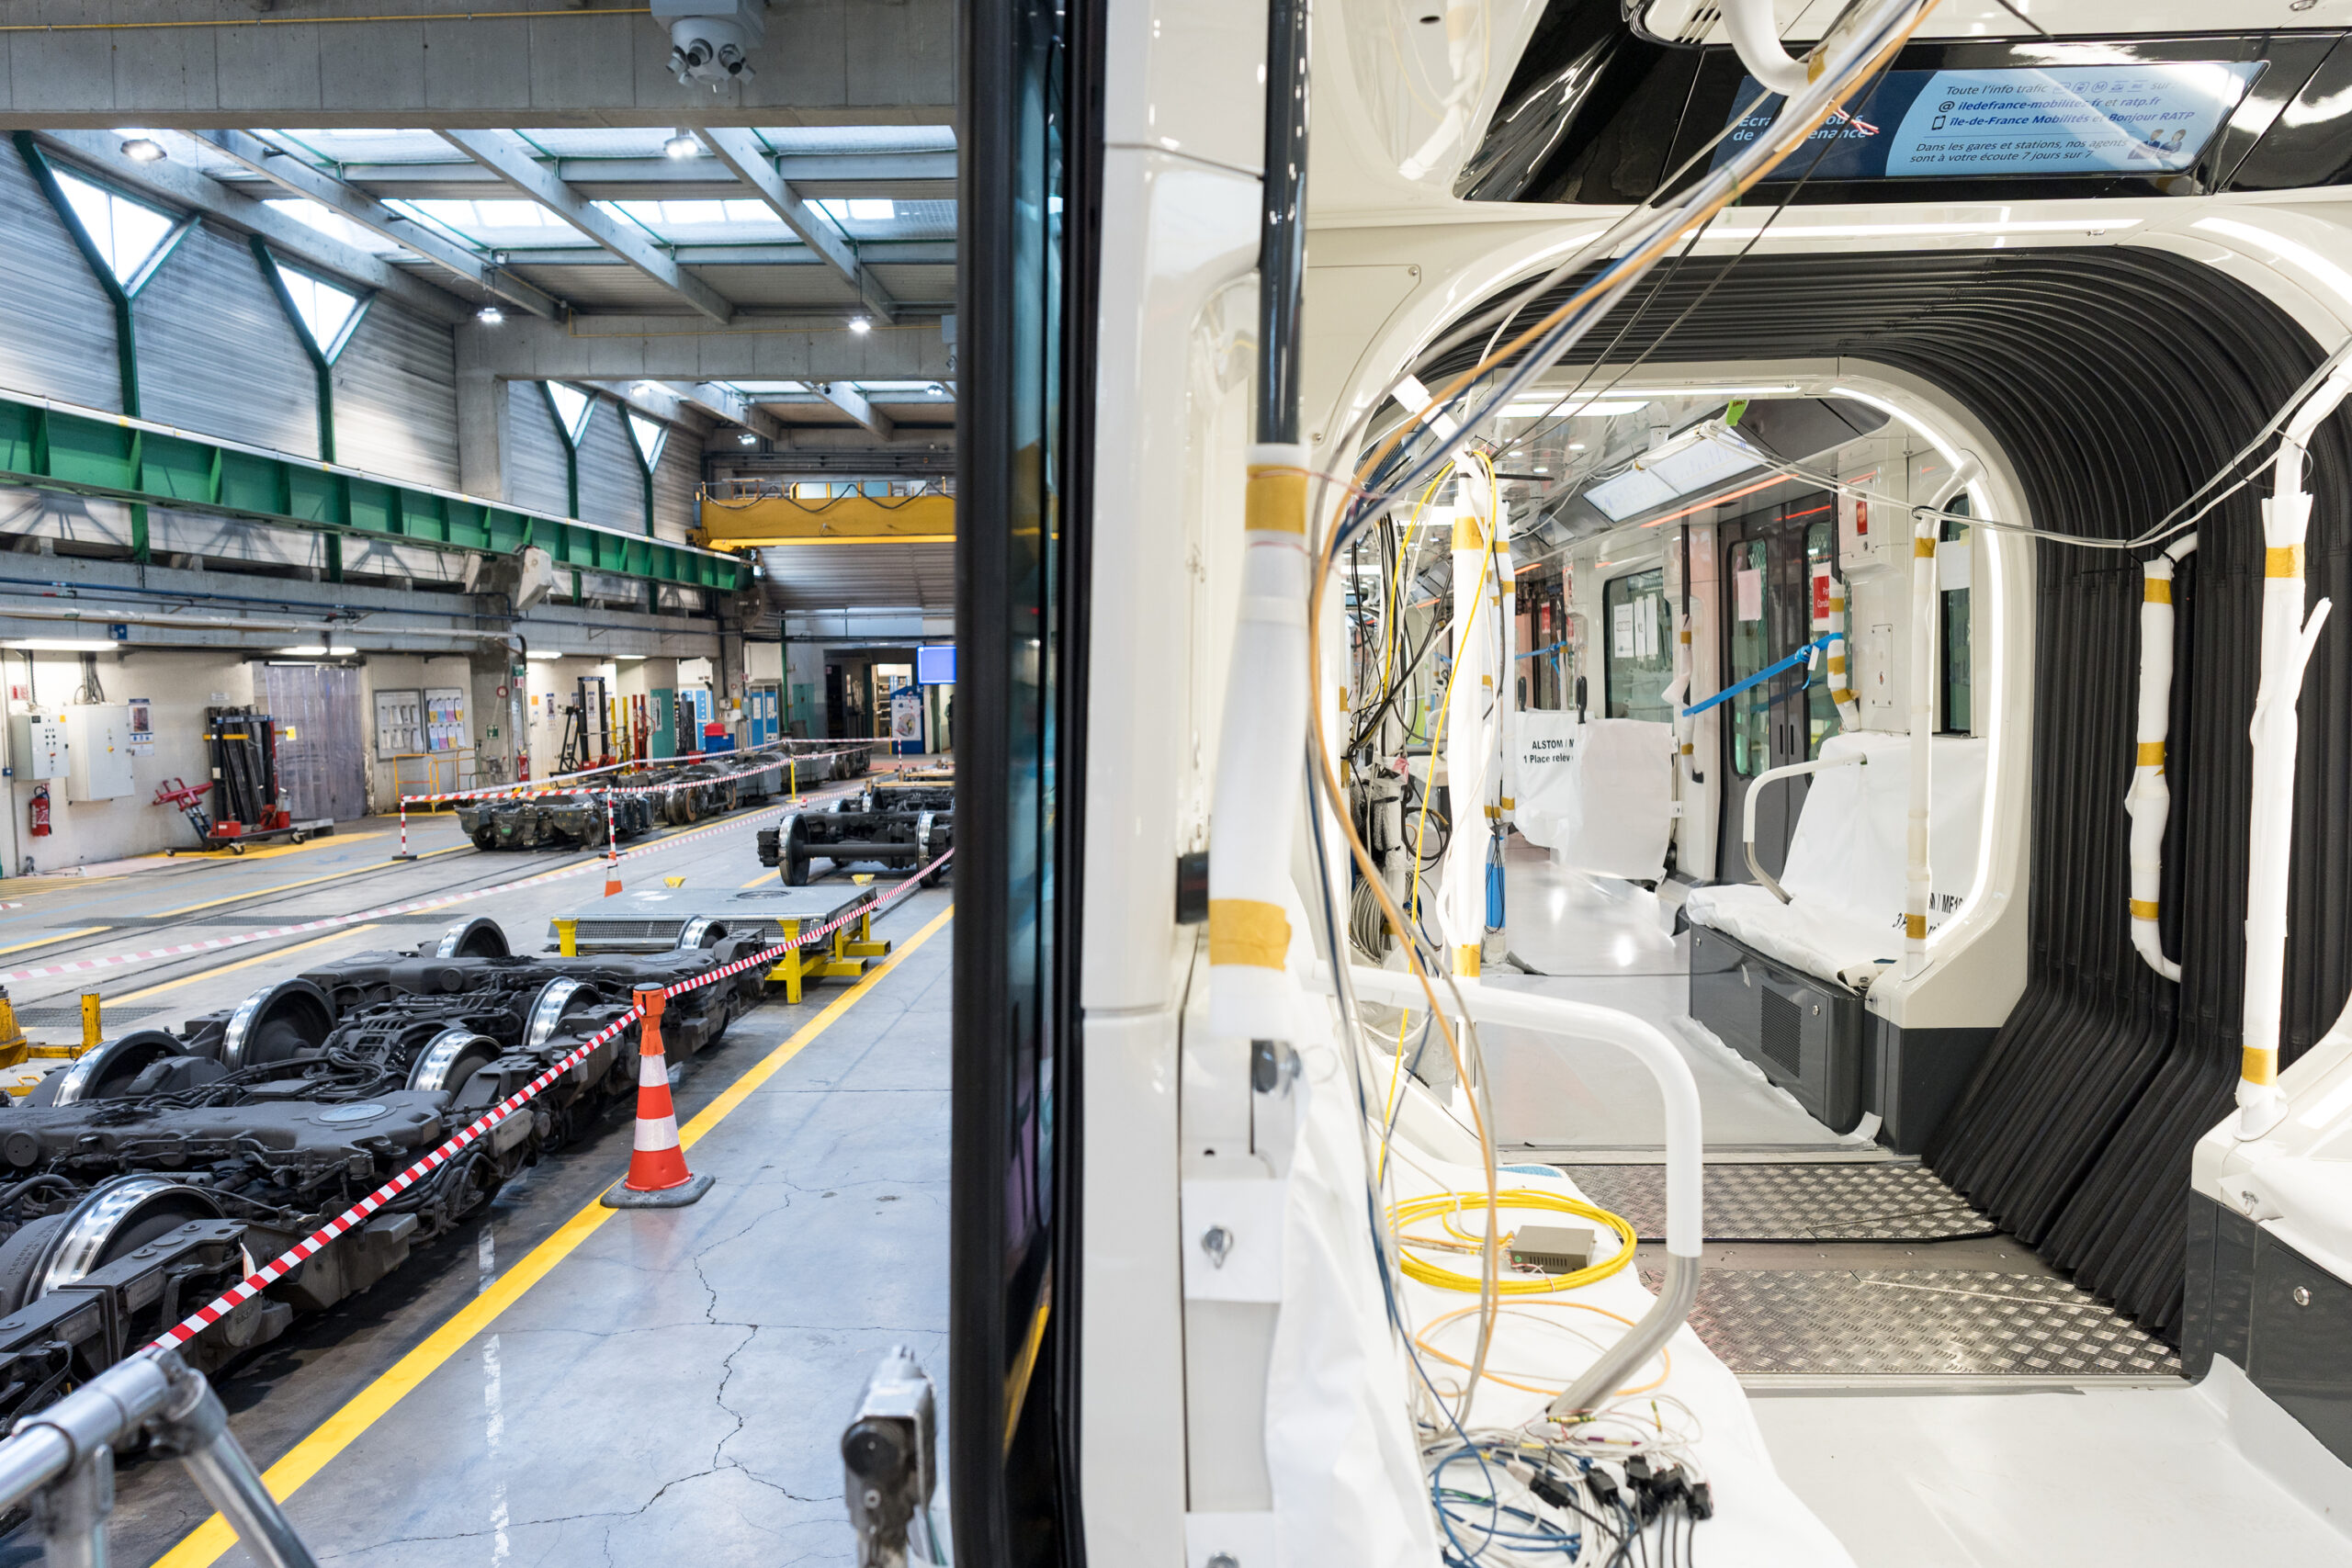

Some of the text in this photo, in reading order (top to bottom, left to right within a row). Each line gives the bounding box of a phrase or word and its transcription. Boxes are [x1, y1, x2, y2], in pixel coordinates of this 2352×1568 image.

[1947, 86, 1979, 95] Toute
[2017, 84, 2049, 94] trafic
[2105, 98, 2117, 107] et
[2120, 96, 2161, 108] ratp.fr
[2031, 113, 2089, 124] Mobilités
[2109, 112, 2159, 124] Bonjour
[2159, 111, 2196, 121] RATP
[1733, 129, 1754, 141] de
[1916, 138, 2128, 152] Dans les gares et stations, nos agents
[1909, 150, 2094, 164] sont à votre écoute 7 jours sur 7
[1532, 739, 1564, 750] ALSTOM
[1530, 754, 1551, 763] Place
